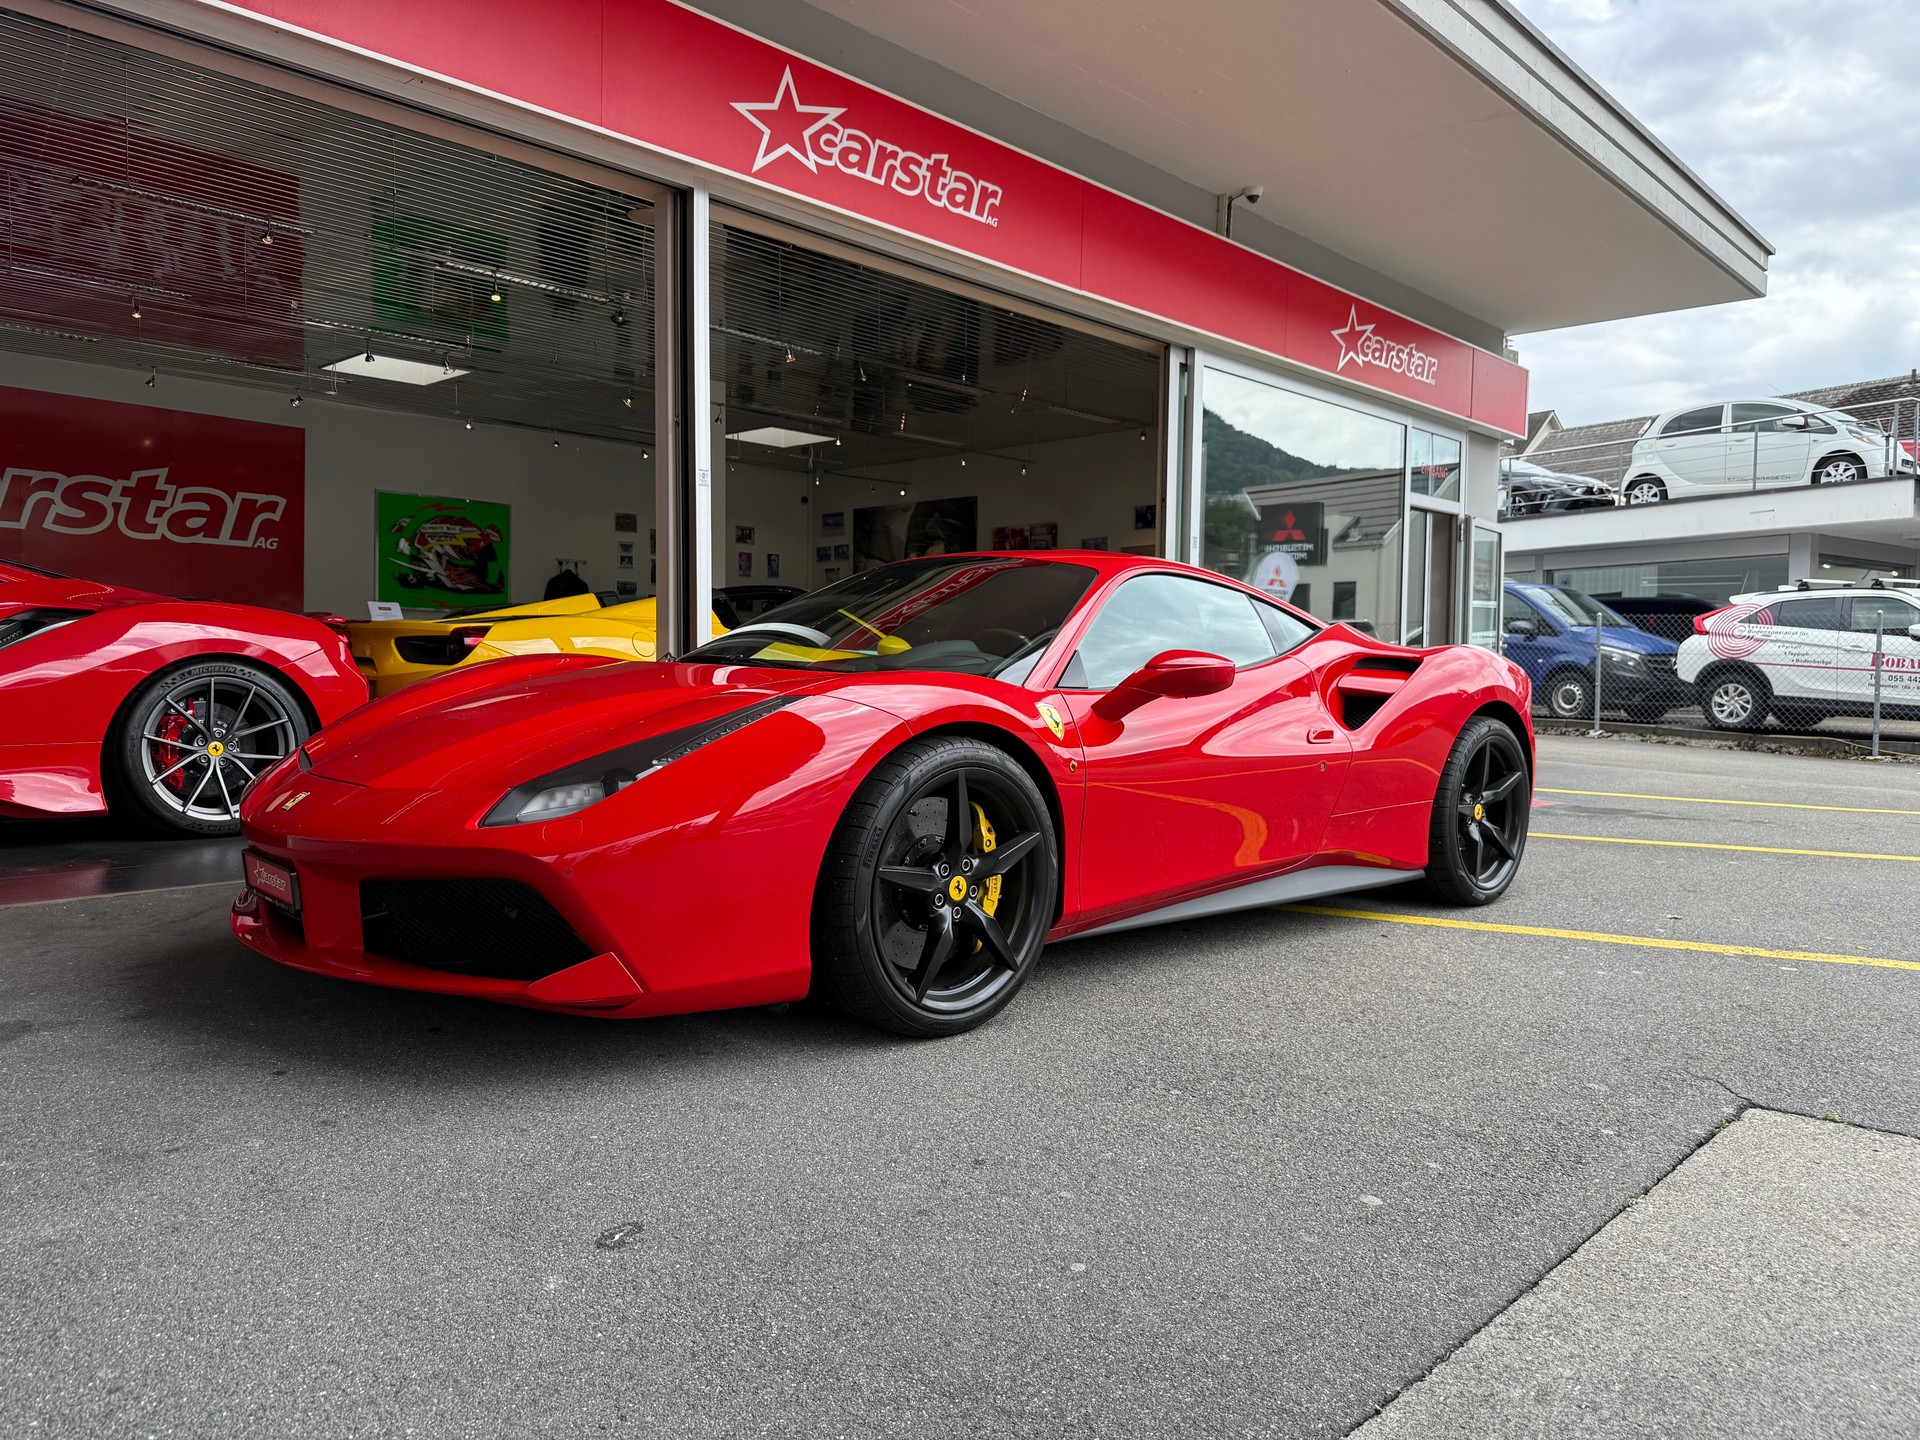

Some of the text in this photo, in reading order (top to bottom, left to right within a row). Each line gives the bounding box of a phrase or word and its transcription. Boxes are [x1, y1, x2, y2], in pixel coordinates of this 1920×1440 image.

[808, 120, 1003, 224] carstar
[986, 216, 999, 228] AG
[1359, 333, 1438, 383] carstar
[0, 467, 287, 547] rstar
[254, 537, 279, 550] AG
[191, 665, 236, 676] MICHELIN
